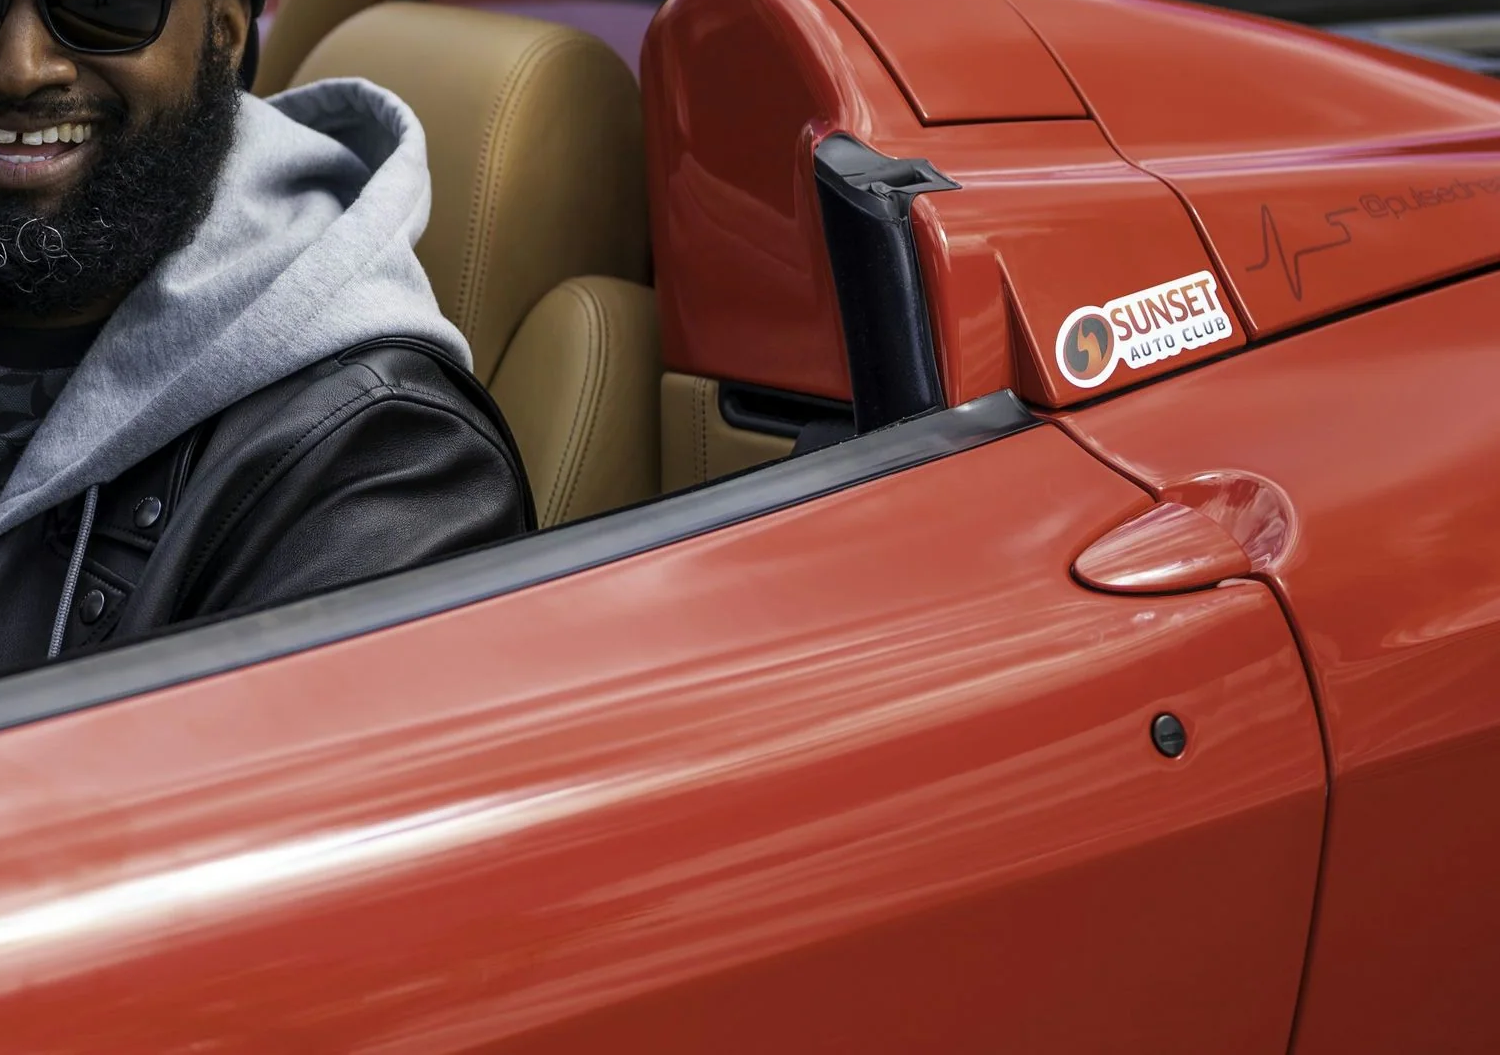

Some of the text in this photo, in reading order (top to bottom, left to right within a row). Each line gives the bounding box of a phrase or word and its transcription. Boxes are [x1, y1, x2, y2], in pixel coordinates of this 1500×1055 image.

[1109, 278, 1216, 341] SUNSET
[1130, 316, 1226, 361] AUTO CLUB
